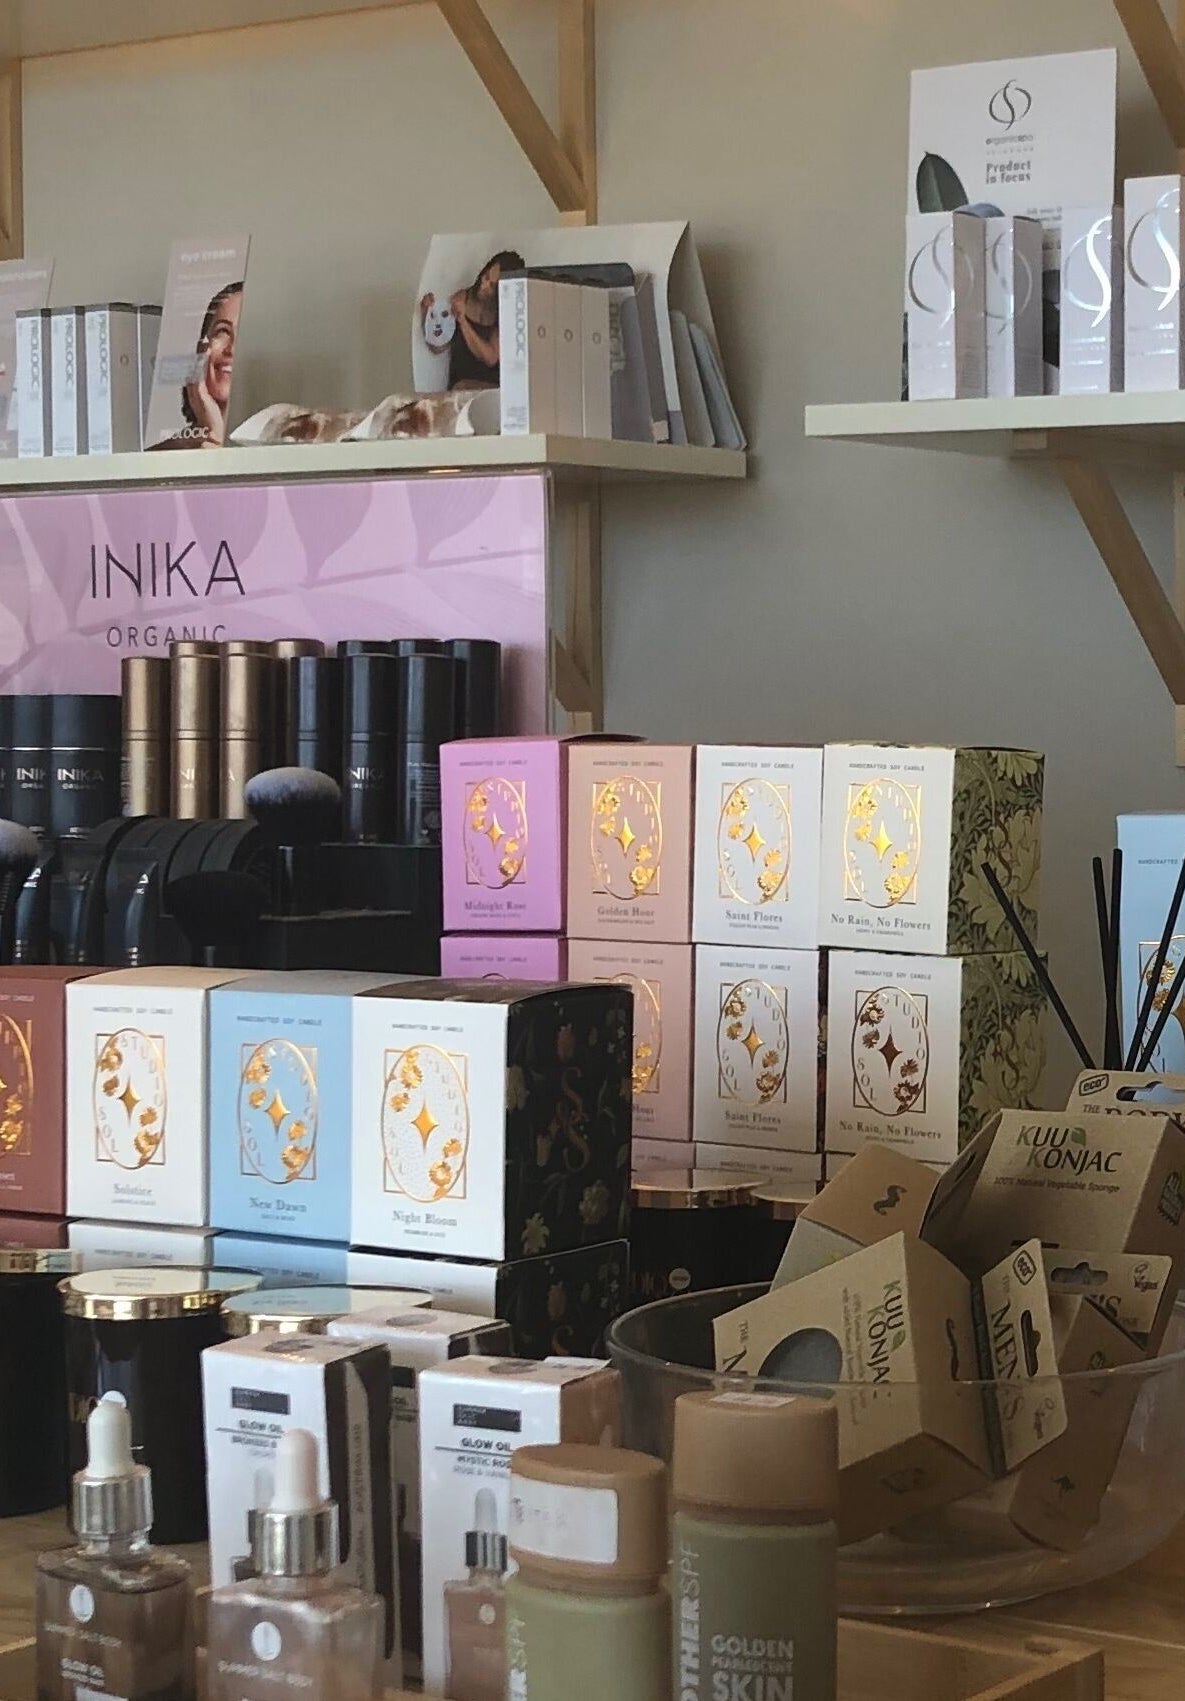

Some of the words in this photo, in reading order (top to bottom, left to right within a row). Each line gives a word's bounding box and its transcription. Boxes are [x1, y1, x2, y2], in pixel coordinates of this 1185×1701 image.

[986, 161, 1031, 173] Product
[986, 173, 997, 184] in
[1001, 172, 1031, 183] focus
[91, 540, 245, 598] INIKA
[107, 625, 226, 647] ORGANIC
[598, 906, 628, 917] Golden
[631, 907, 655, 917] Hour
[725, 910, 751, 922] Saint
[753, 911, 783, 923] Flores
[831, 913, 845, 924] No
[848, 914, 873, 928] Rain,
[877, 916, 891, 928] No
[894, 917, 931, 930] Flowers
[882, 993, 926, 1060] STUDIO
[857, 1057, 878, 1101] SOL
[1083, 1104, 1100, 1114] THE
[725, 1110, 750, 1122] Saint
[753, 1112, 782, 1125] Flores
[99, 1107, 120, 1153] SOL
[839, 1120, 852, 1131] No
[855, 1121, 883, 1136] Rain,
[886, 1124, 901, 1136] No
[904, 1125, 942, 1139] Flowers
[1017, 1126, 1069, 1148] KUU
[1026, 1148, 1122, 1176] KONJAC
[1047, 1179, 1086, 1190] Vegetable
[1088, 1182, 1120, 1194] Sponge
[249, 1197, 272, 1209] New
[276, 1199, 308, 1213] Dawn
[393, 1211, 422, 1225] Night
[425, 1213, 458, 1227] Bloom
[883, 1280, 904, 1330] KUU
[239, 1419, 267, 1431] GLOW
[461, 1437, 493, 1450] GLOW
[493, 1459, 512, 1469] ROS
[711, 1634, 794, 1660] GOLDEN
[713, 1670, 794, 1701] SKIN
